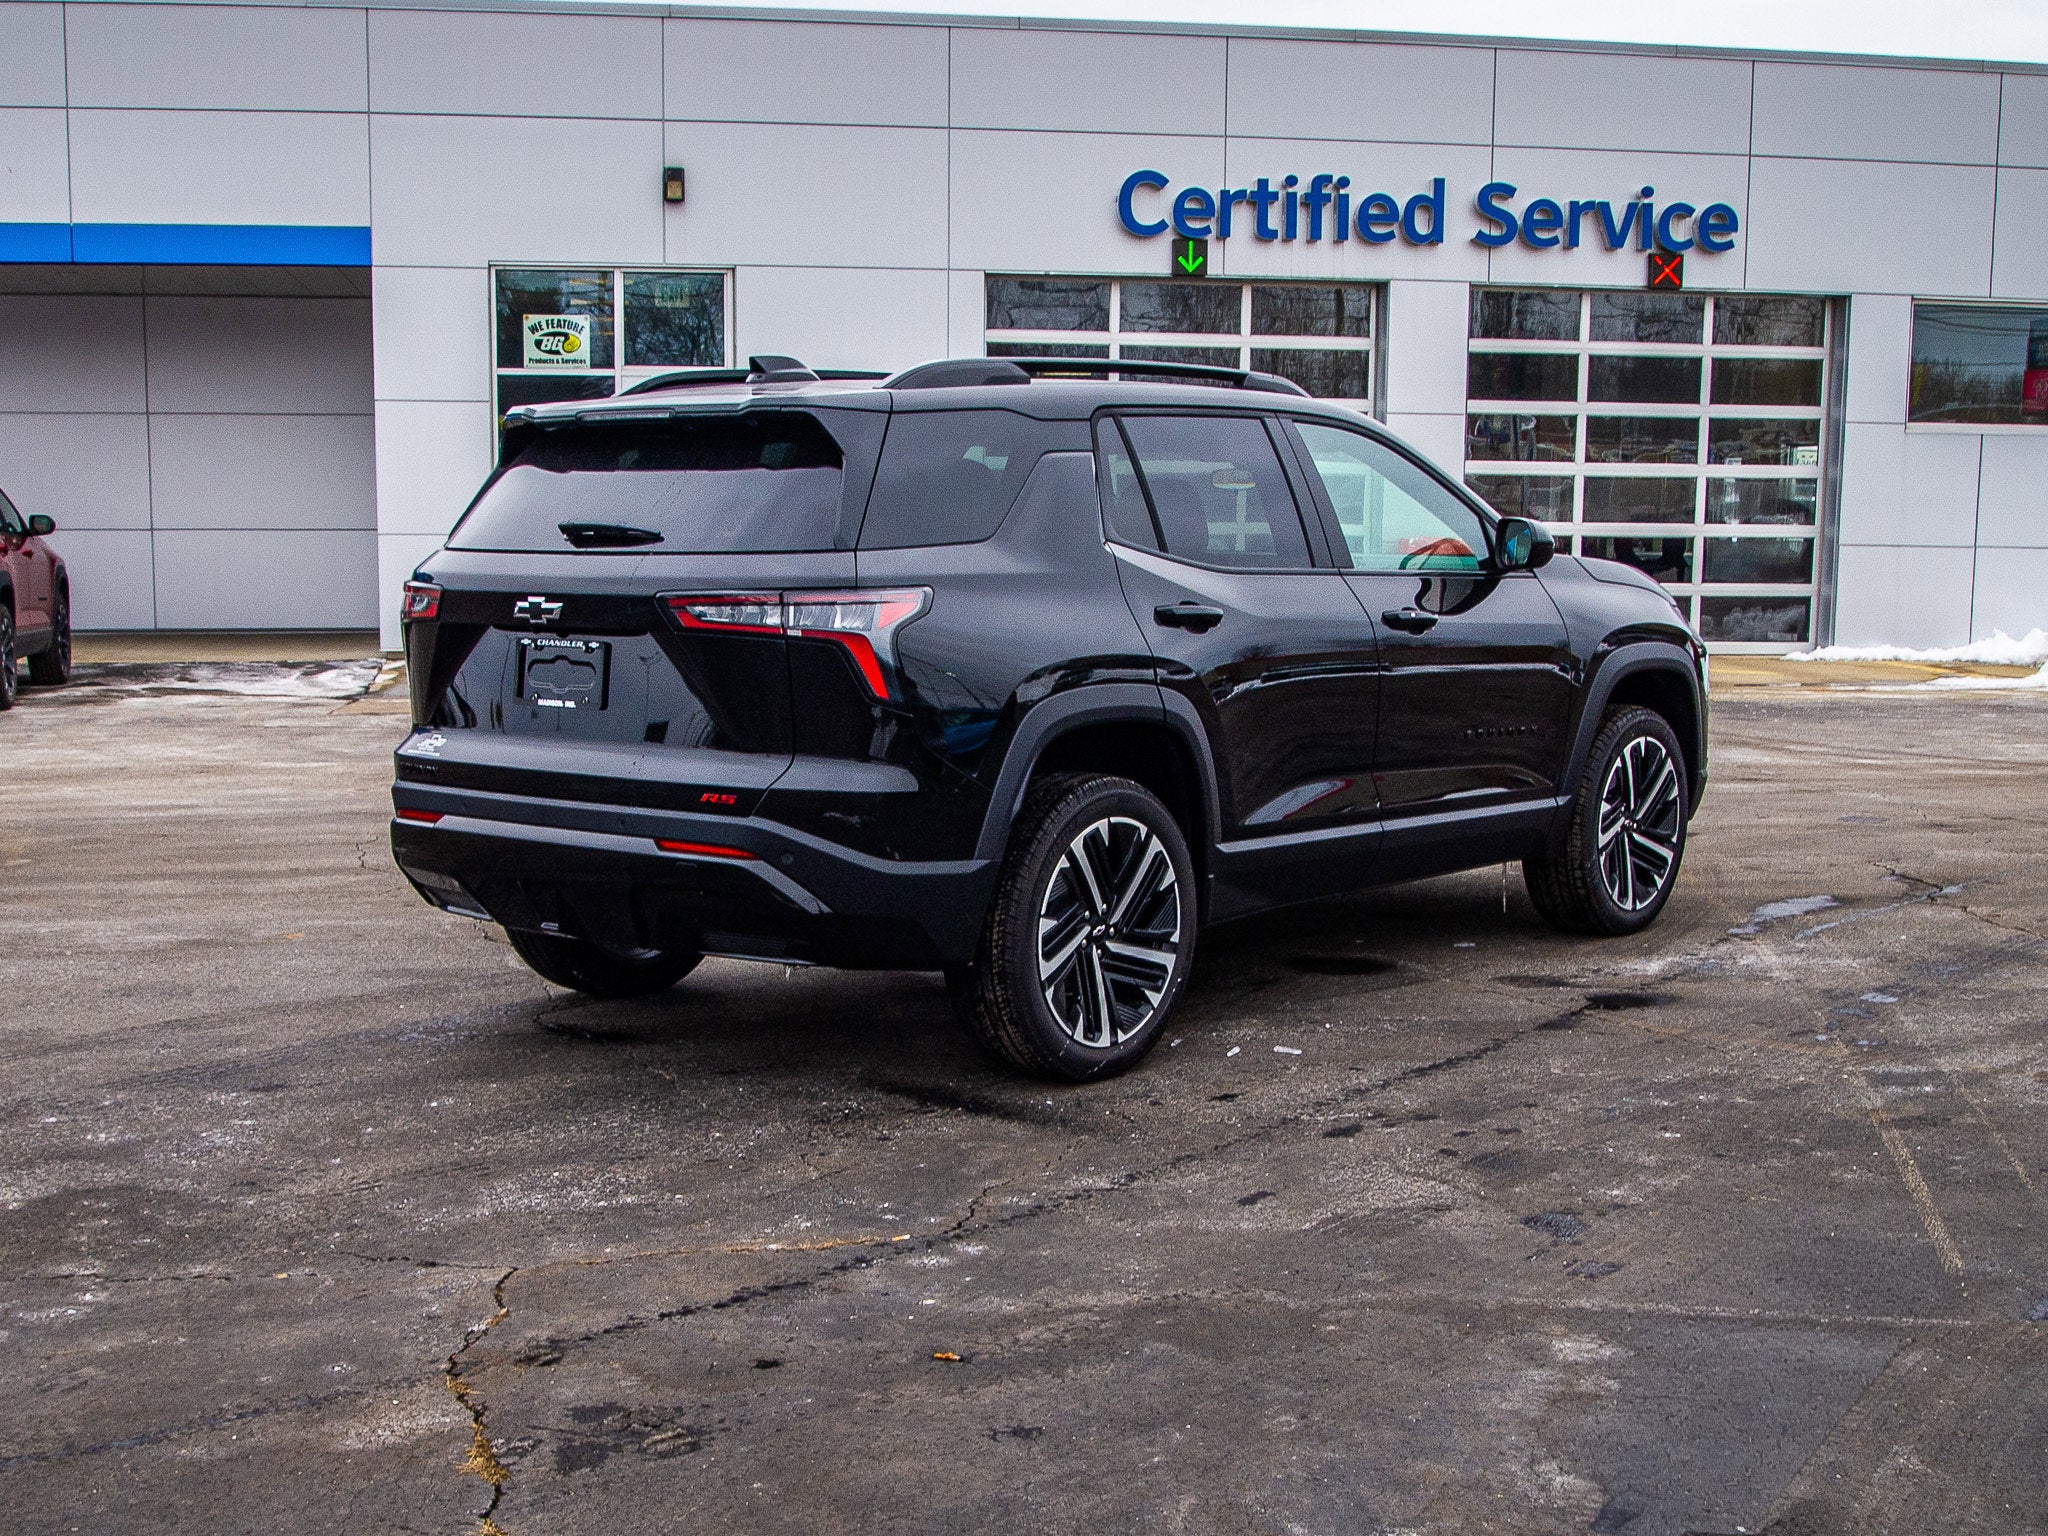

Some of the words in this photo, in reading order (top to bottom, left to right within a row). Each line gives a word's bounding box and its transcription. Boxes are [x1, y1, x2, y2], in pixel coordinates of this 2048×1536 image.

[1118, 170, 1445, 245] Certified
[1472, 182, 1740, 252] Service
[527, 321, 544, 335] WE
[546, 319, 585, 335] FEATURE
[541, 336, 565, 351] BG
[528, 357, 555, 365] Products
[562, 357, 587, 366] Services
[536, 639, 584, 648] CHANDLER
[700, 793, 737, 805] RS
